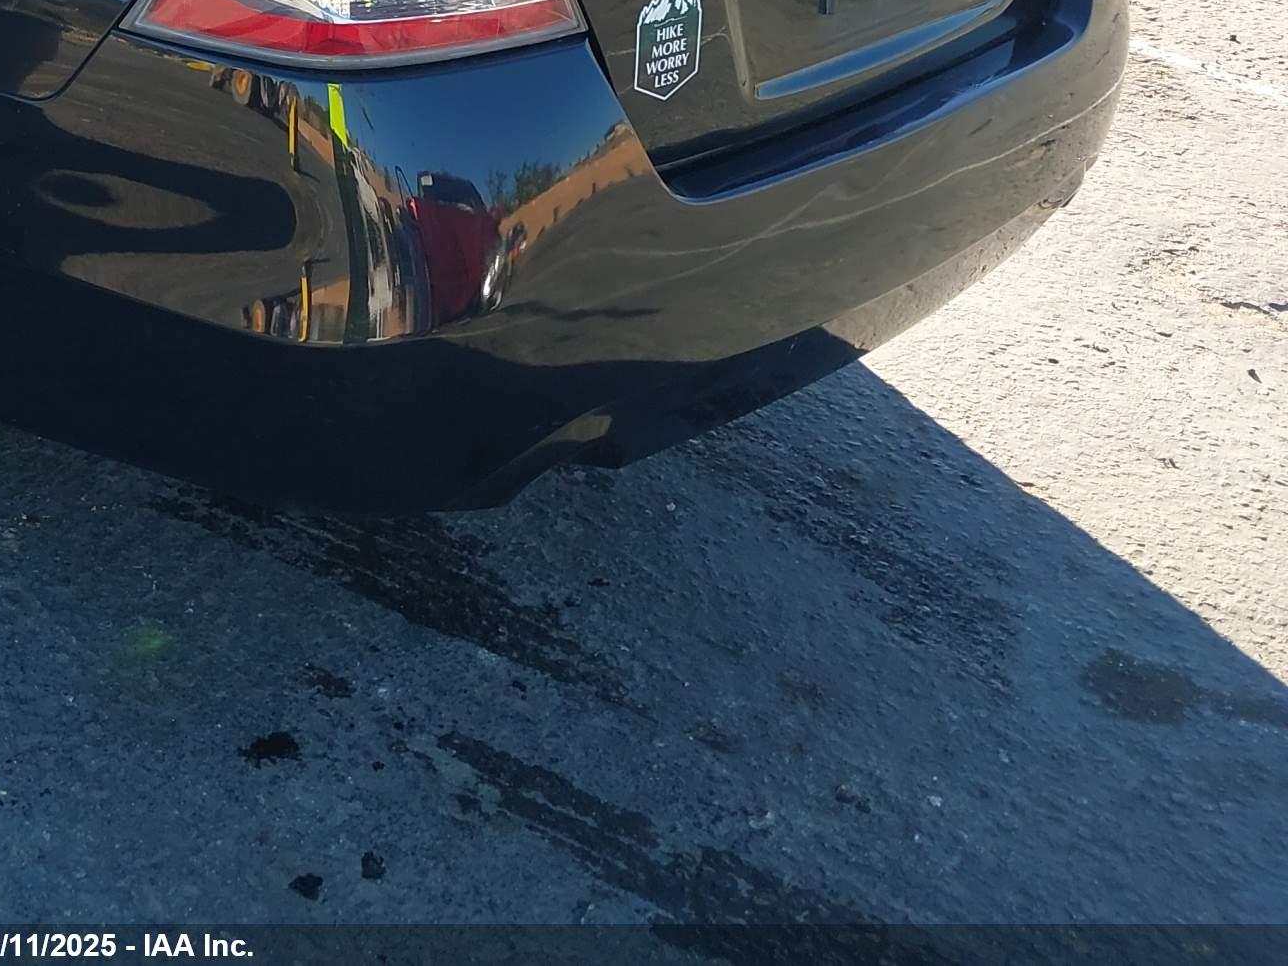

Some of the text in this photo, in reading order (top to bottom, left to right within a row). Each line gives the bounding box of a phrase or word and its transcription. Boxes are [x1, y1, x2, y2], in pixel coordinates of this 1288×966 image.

[656, 23, 684, 42] HIKE
[652, 38, 688, 58] MORE
[646, 52, 690, 75] WORRY
[654, 70, 680, 88] LESS
